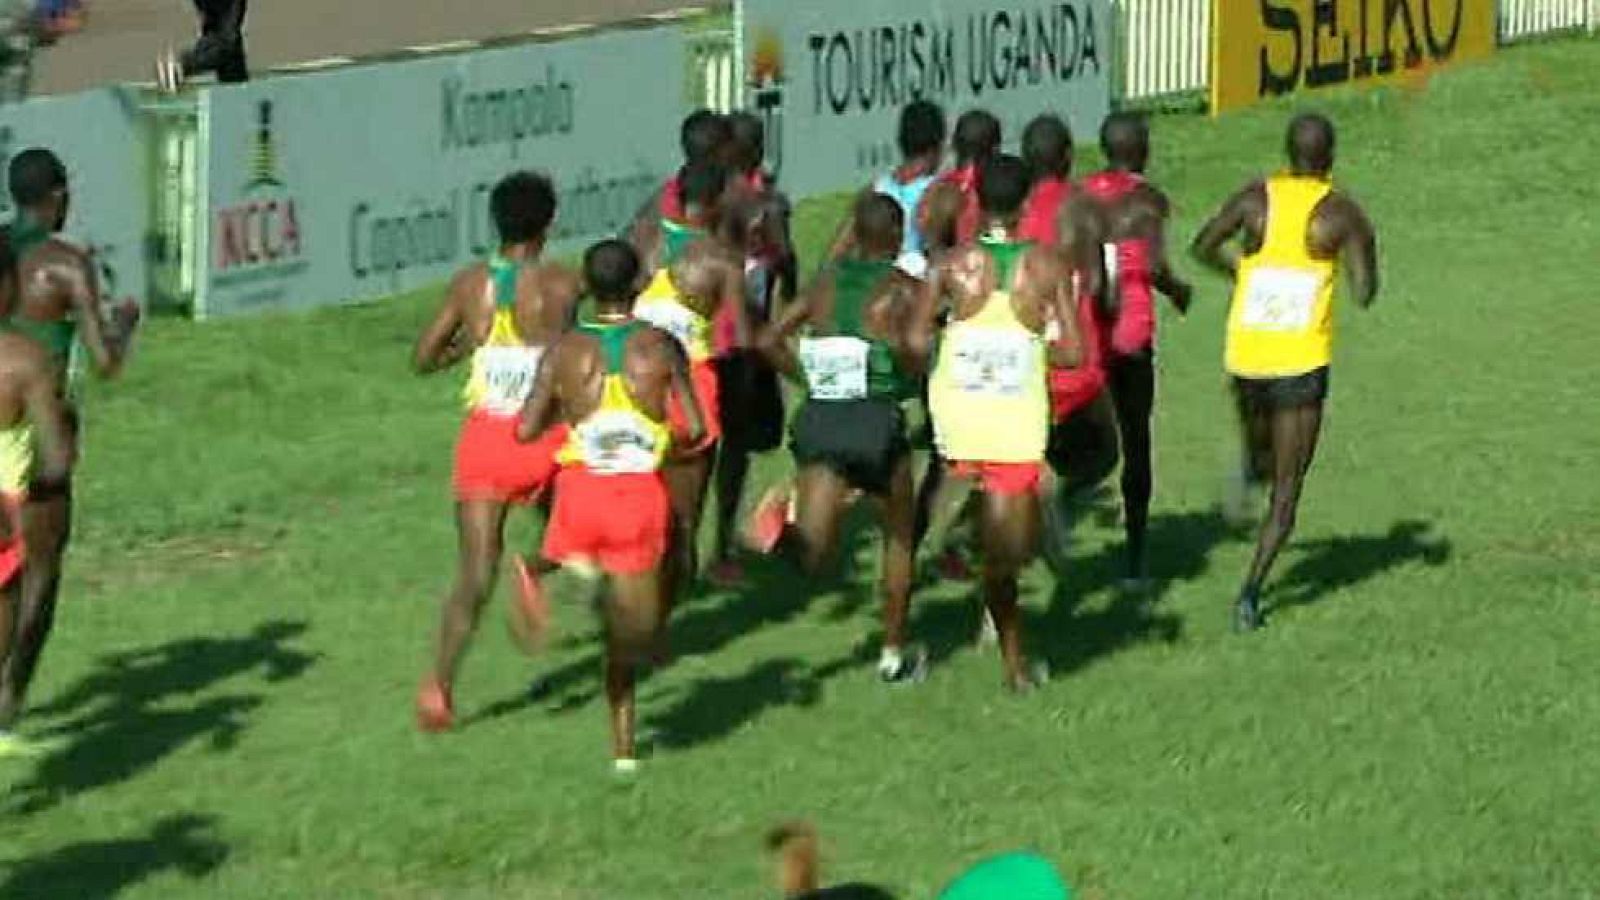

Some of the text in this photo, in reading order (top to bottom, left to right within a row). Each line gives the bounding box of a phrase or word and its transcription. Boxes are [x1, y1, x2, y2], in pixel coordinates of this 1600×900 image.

[807, 3, 1100, 115] TOURISM UGANDA
[440, 66, 574, 158] Kampala
